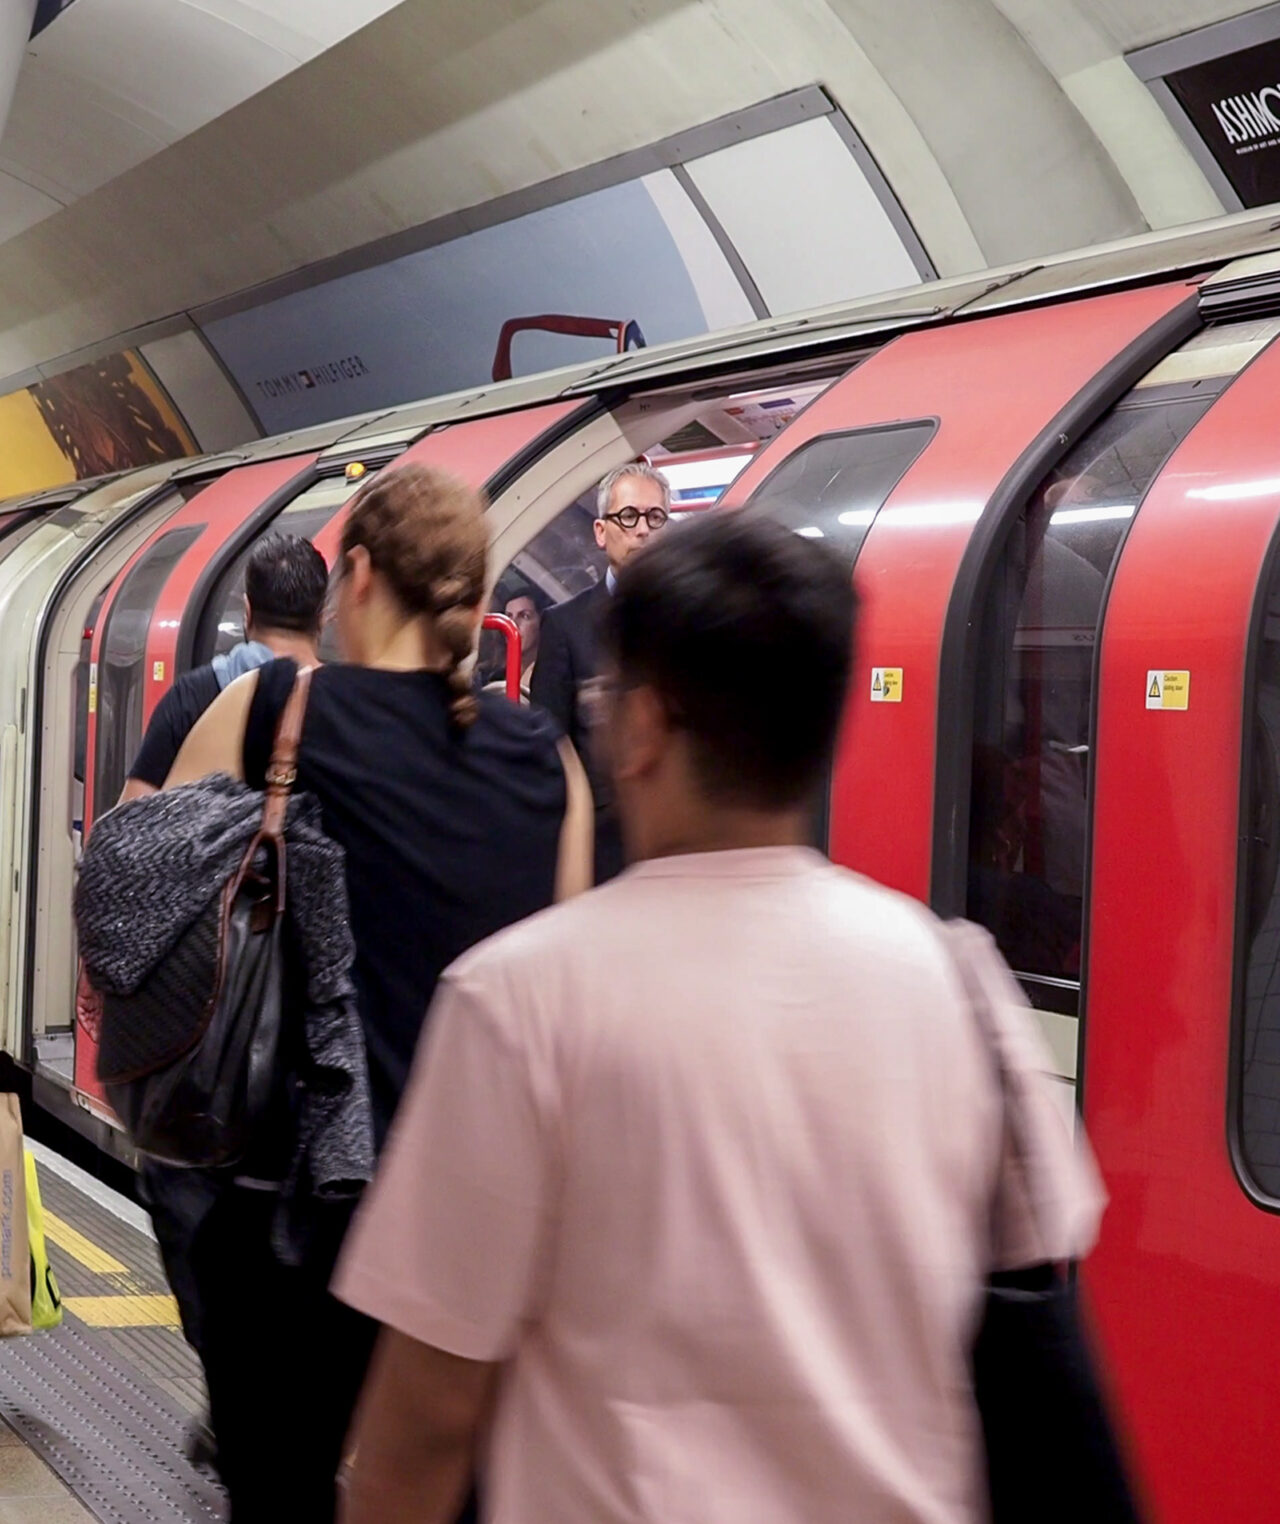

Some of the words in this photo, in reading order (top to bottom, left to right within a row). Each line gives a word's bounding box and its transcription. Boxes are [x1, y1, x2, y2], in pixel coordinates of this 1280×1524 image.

[1211, 84, 1280, 144] ASHMO
[256, 373, 302, 399] TOMMY
[310, 354, 370, 385] HILFIGER
